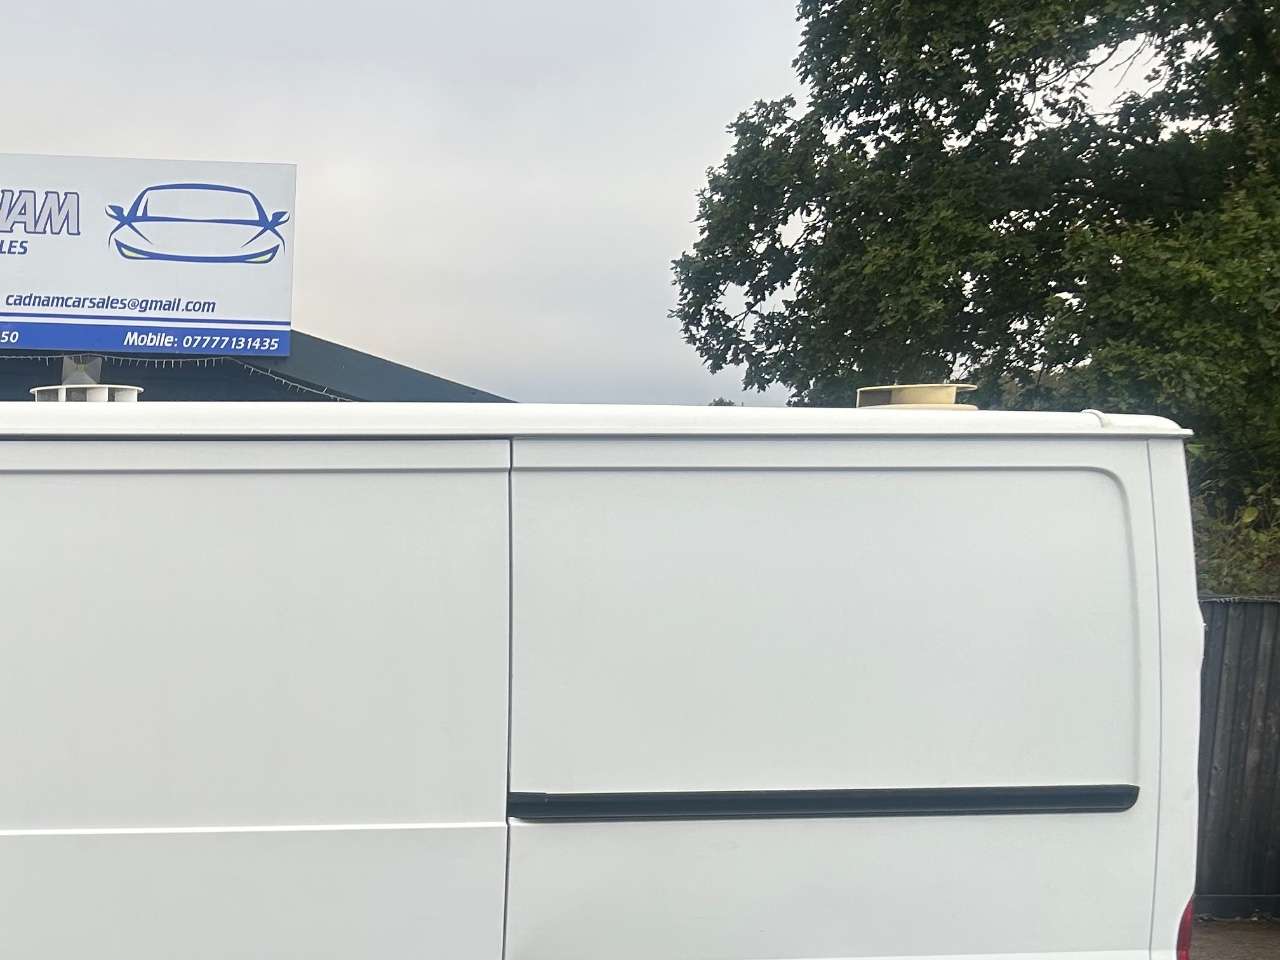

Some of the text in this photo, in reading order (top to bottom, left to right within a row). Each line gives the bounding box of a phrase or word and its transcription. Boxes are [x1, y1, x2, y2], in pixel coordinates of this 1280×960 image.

[5, 292, 217, 313] cadnamcarsales@gmail.com
[123, 331, 280, 351] Mobile: 07777131435
